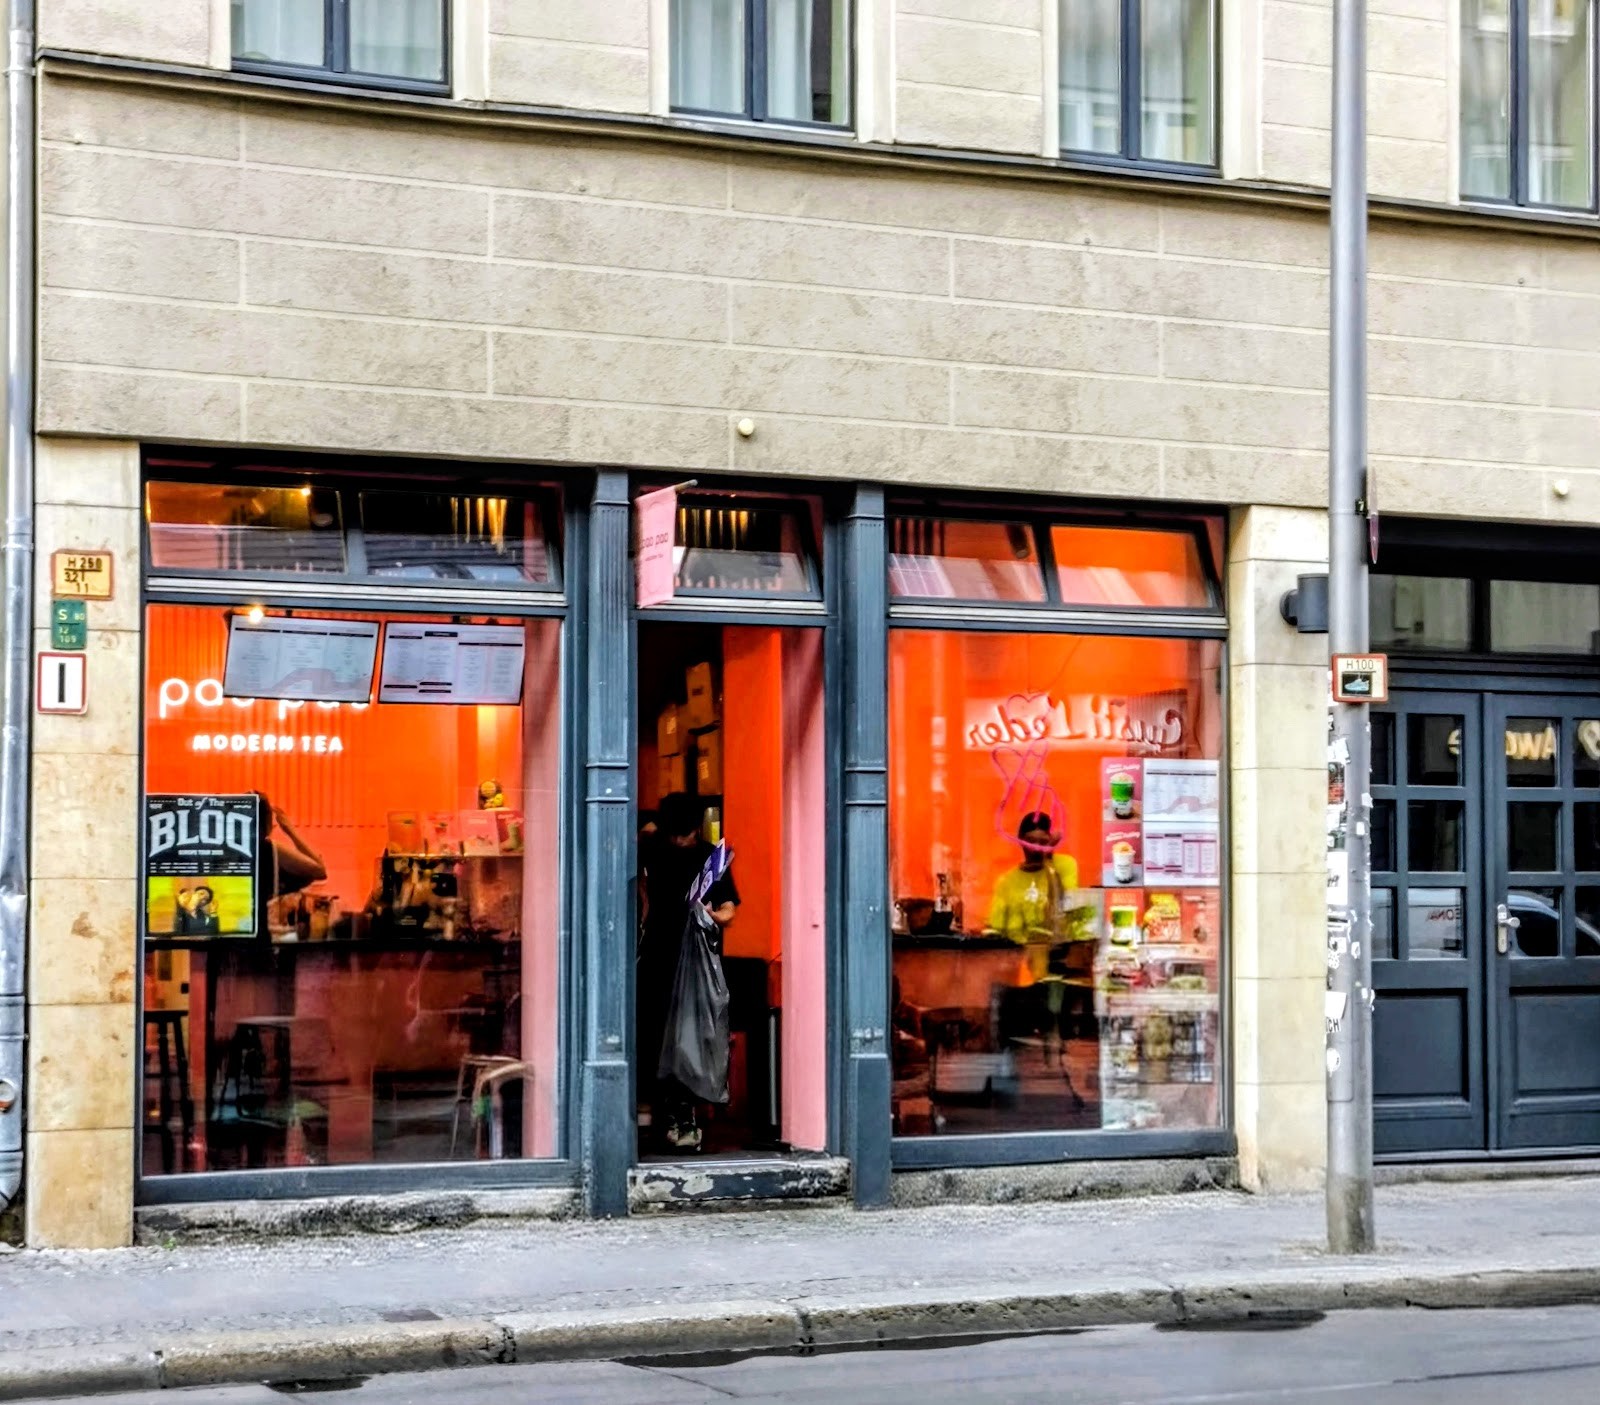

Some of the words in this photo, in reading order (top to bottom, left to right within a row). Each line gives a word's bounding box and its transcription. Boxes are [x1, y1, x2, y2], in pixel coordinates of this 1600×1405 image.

[67, 557, 77, 567] H
[58, 608, 68, 621] S
[1346, 660, 1353, 669] H
[1355, 659, 1374, 670] 100
[192, 734, 294, 751] MODERN
[301, 735, 344, 752] TEA
[195, 797, 208, 810] of
[209, 797, 225, 807] The
